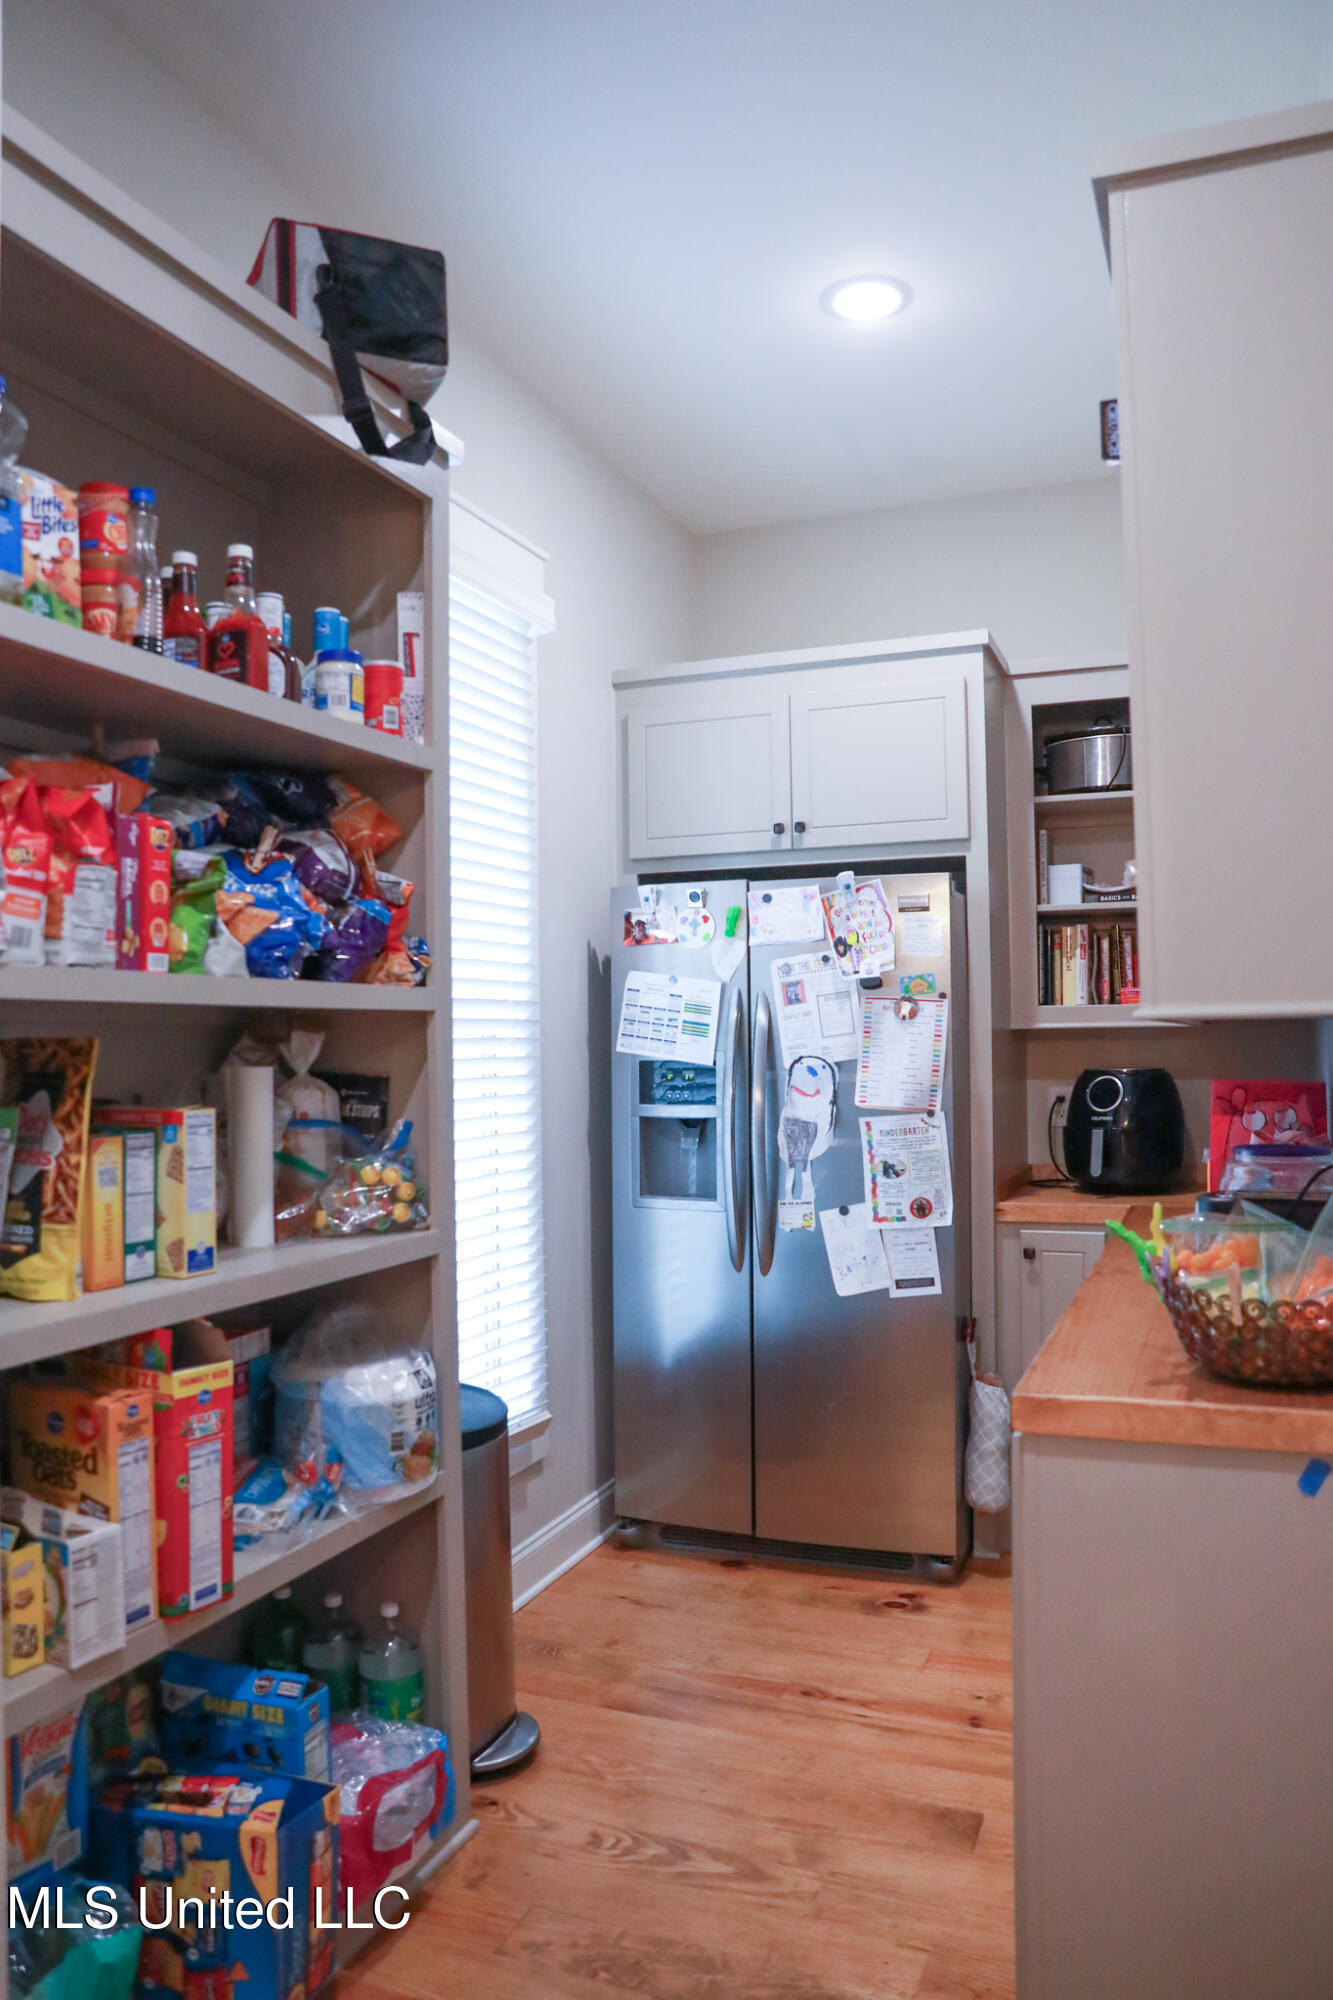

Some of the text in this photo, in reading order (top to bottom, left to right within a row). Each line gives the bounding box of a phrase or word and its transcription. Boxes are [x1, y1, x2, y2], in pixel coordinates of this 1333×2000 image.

[30, 495, 65, 520] Little
[41, 515, 78, 535] Bites
[879, 1127, 930, 1137] KINDERGARTEN
[103, 1203, 114, 1262] original
[16, 1428, 98, 1475] Toasted
[33, 1458, 78, 1489] Oats
